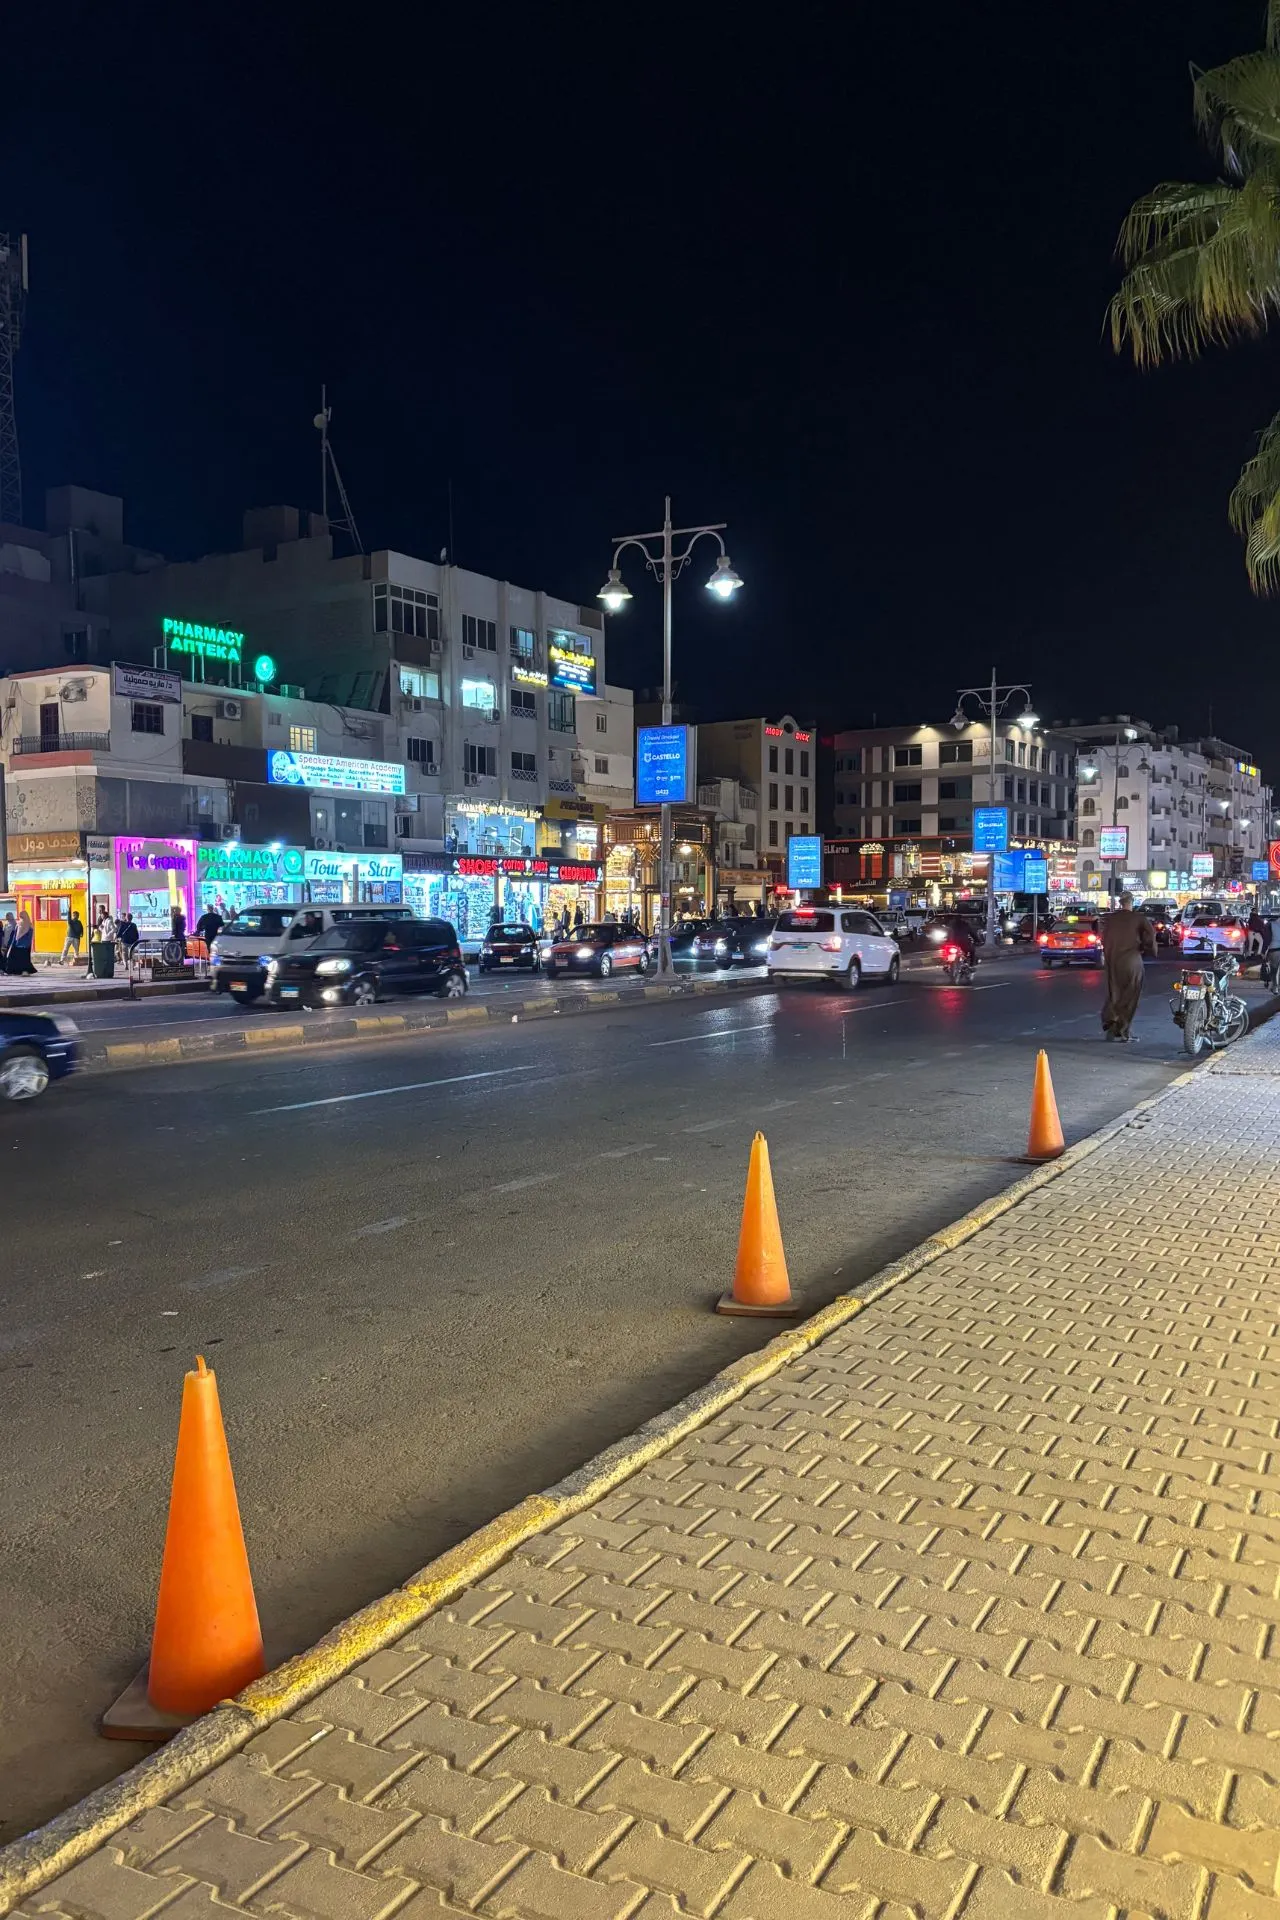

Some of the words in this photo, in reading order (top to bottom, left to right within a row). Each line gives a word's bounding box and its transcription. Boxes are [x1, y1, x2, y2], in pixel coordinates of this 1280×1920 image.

[163, 618, 244, 647] PHARMACY
[170, 637, 240, 661] АПТЕКА
[795, 732, 810, 742] DICK
[651, 753, 681, 761] CASTELLO
[301, 764, 327, 773] Language
[336, 760, 368, 770] American
[372, 763, 402, 775] Academy
[127, 853, 147, 869] Ice
[147, 853, 188, 870] Cream
[199, 848, 280, 865] PHARMACY
[206, 866, 275, 880] АПТЕКА
[311, 858, 343, 876] Tour
[368, 860, 396, 877] Star
[459, 858, 498, 875] SHOES
[560, 865, 597, 881] CLEOPATRA
